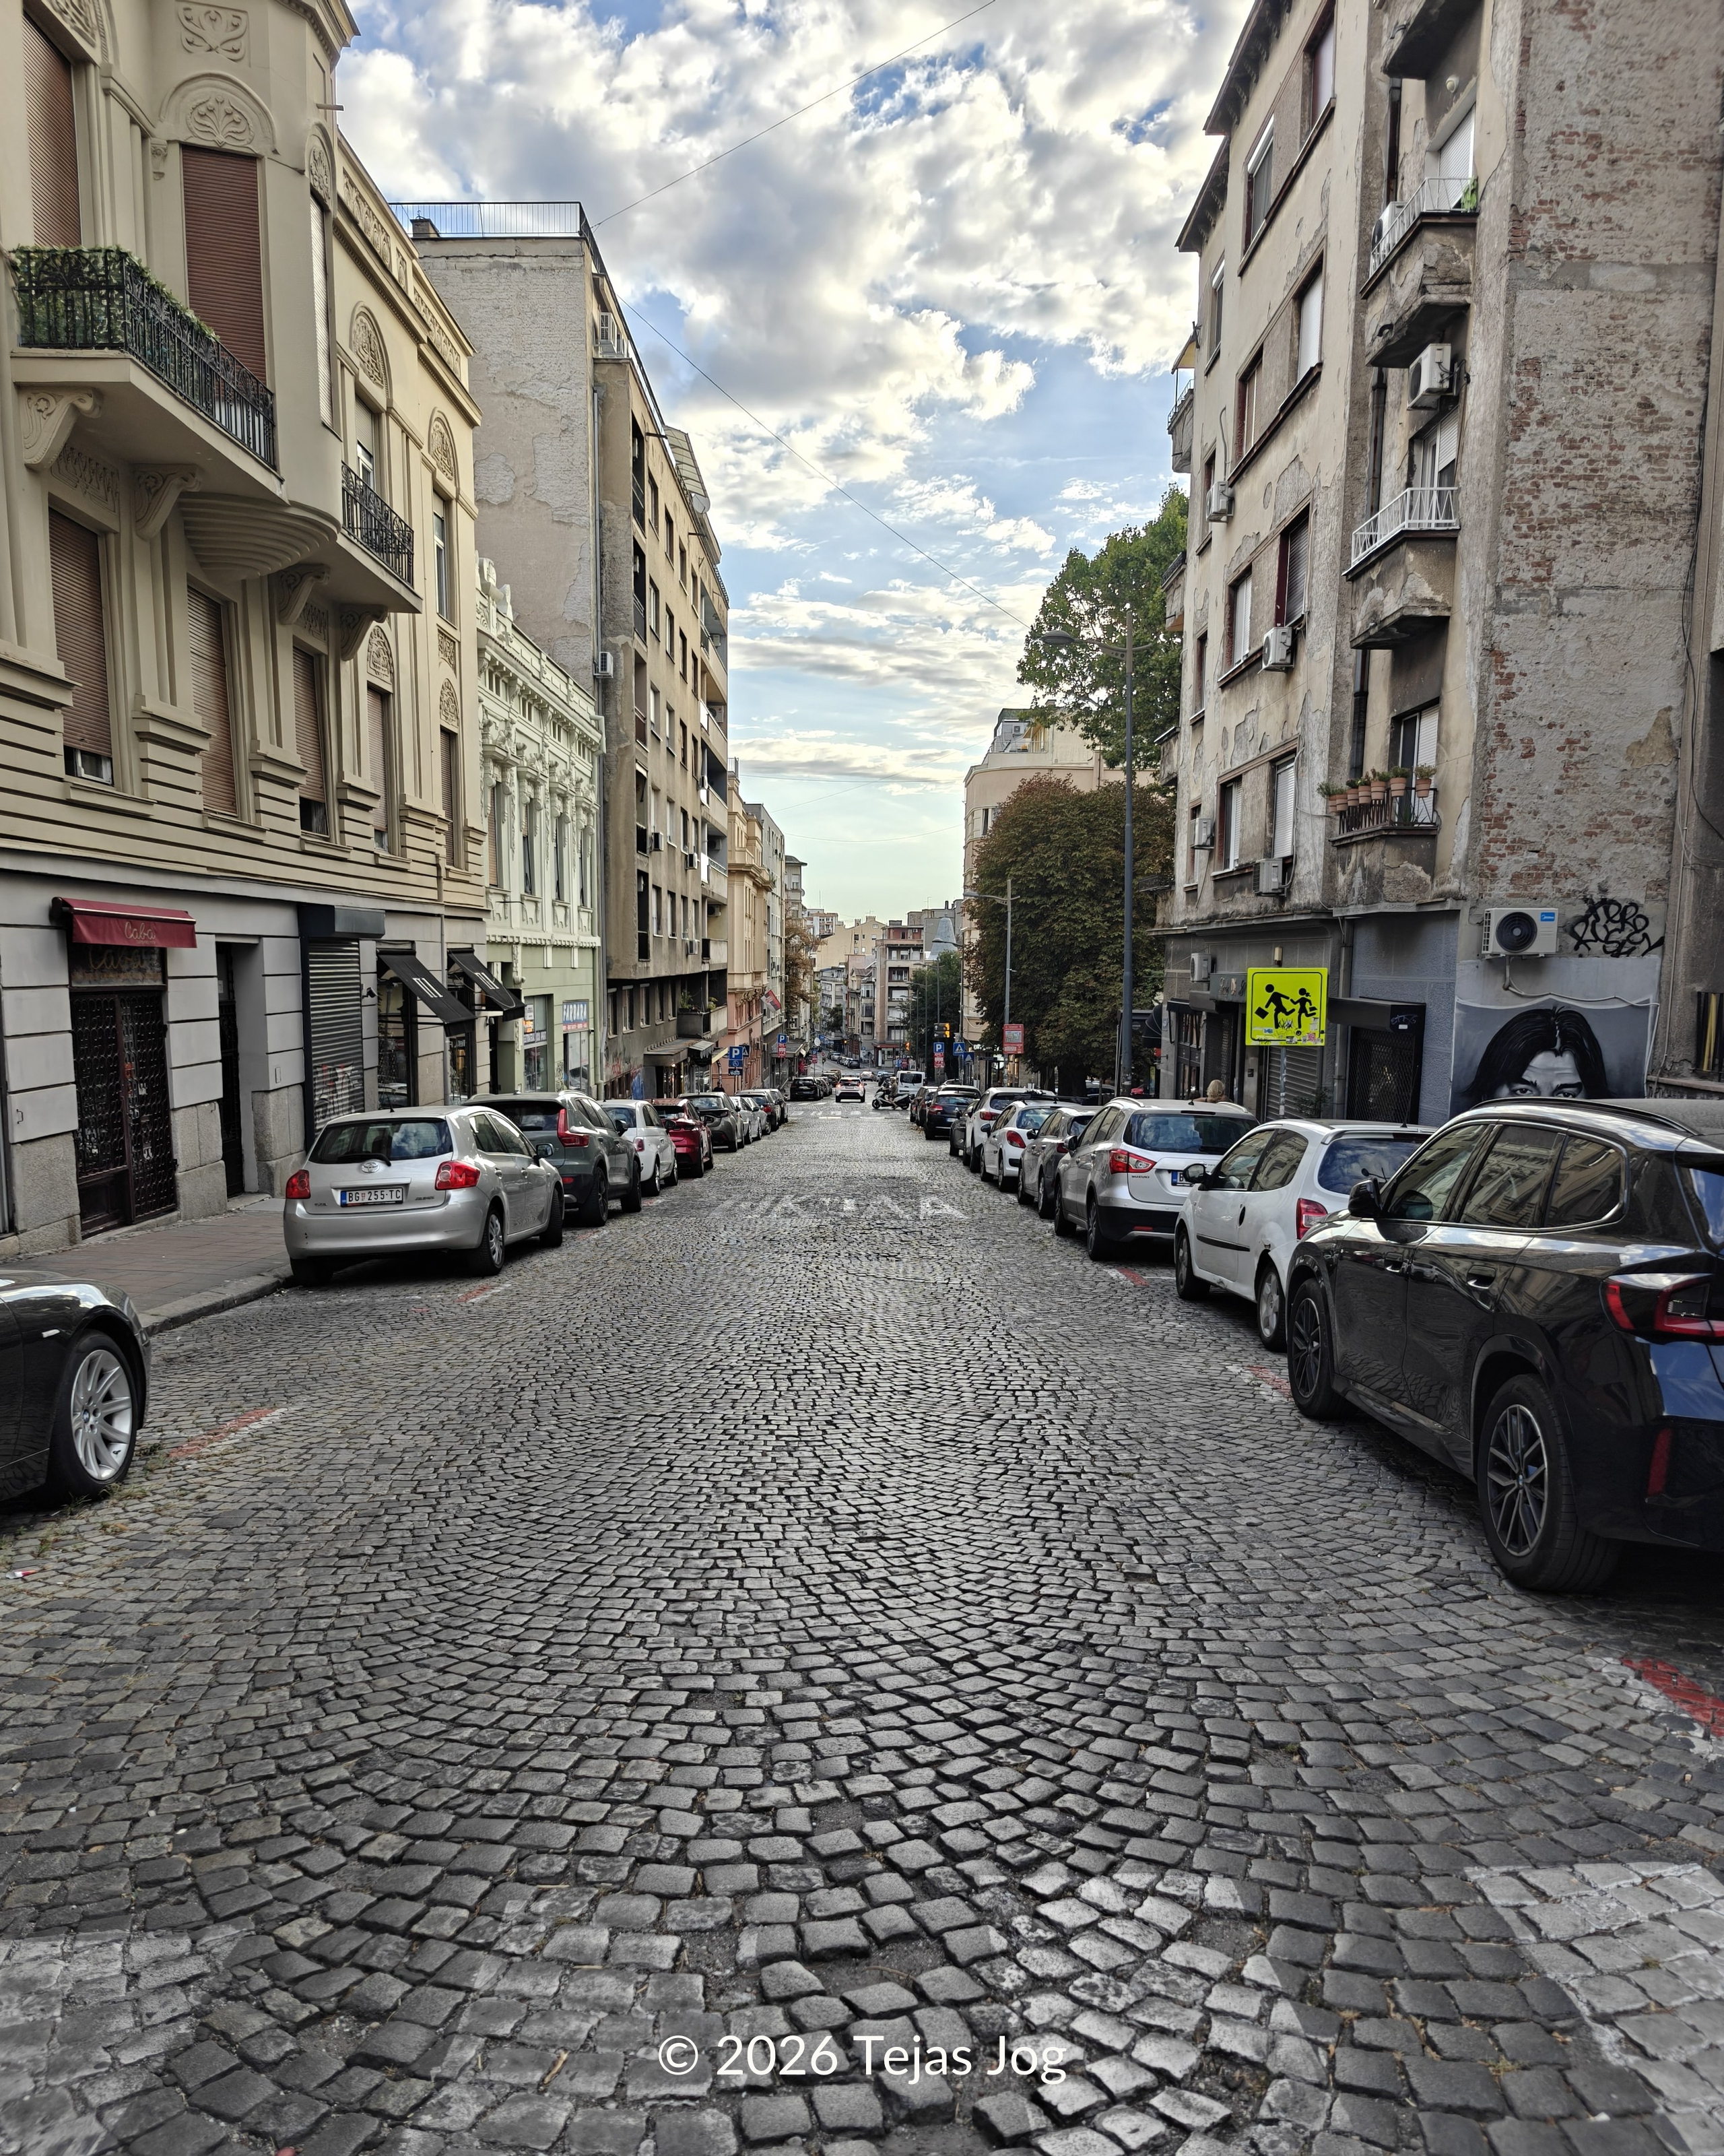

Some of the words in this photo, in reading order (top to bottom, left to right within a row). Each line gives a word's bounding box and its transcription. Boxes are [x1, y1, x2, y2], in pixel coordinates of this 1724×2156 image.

[125, 921, 156, 940] Caba
[732, 1047, 740, 1058] P
[348, 1191, 360, 1202] BG
